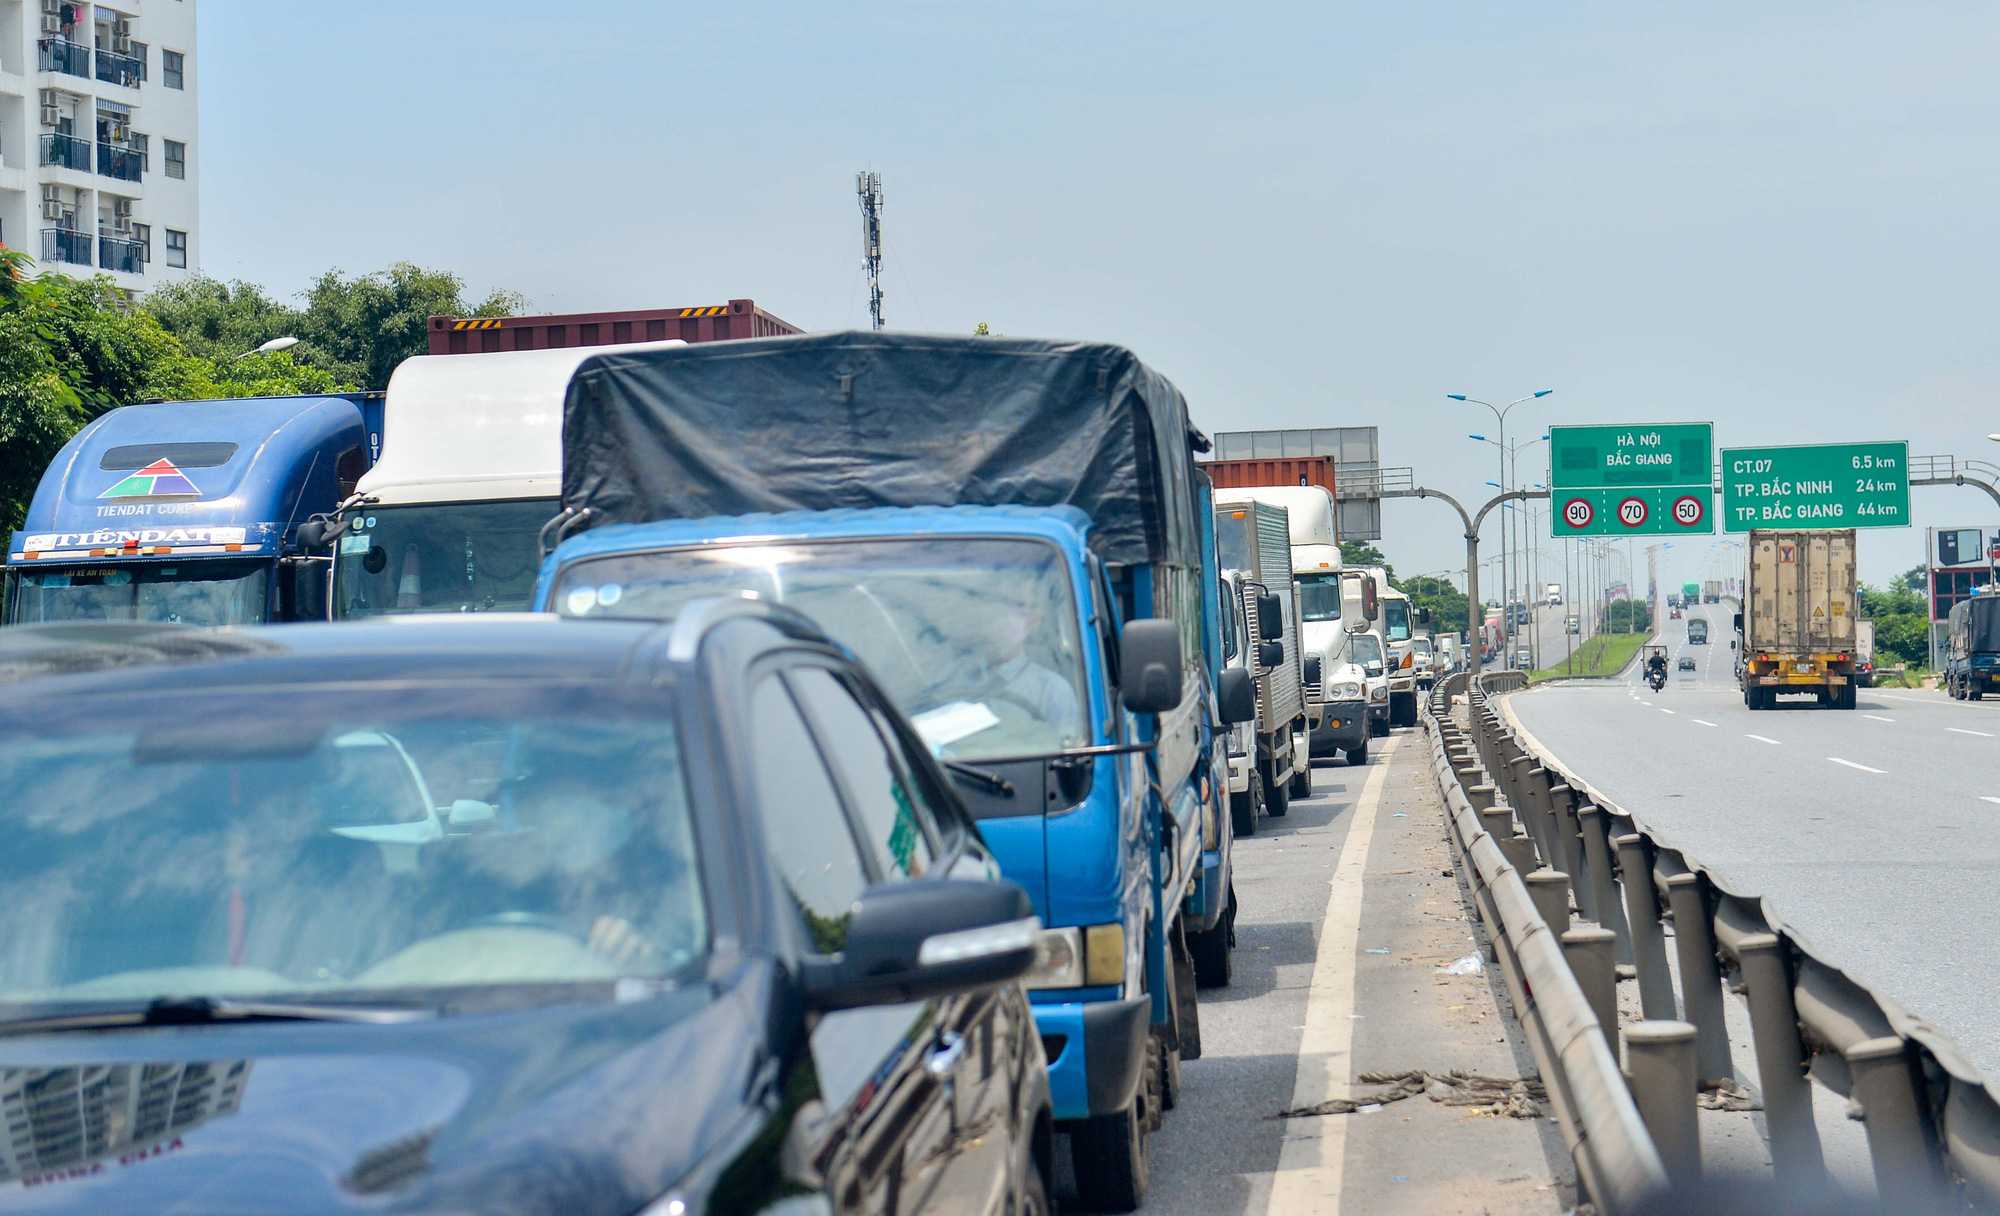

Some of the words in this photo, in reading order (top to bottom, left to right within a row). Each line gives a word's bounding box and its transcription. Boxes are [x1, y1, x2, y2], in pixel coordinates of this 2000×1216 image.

[1617, 432, 1635, 446] HÀ
[1640, 431, 1661, 448] NỘI
[1606, 449, 1631, 466] BẮC
[1635, 453, 1673, 465] GIANG
[1733, 459, 1773, 474] CT.07
[1852, 455, 1872, 469] 6.5
[1876, 457, 1895, 468] km
[1796, 480, 1833, 495] NINH
[1856, 478, 1875, 493] 24
[1876, 480, 1896, 492] km
[97, 504, 154, 517] TIENDAT
[1570, 505, 1587, 520] 90
[1624, 504, 1642, 519] 70
[1678, 503, 1696, 518] 50
[1762, 499, 1793, 520] BẮC
[1797, 503, 1844, 519] GIANG
[1857, 502, 1876, 516] 44
[1877, 503, 1898, 515] km
